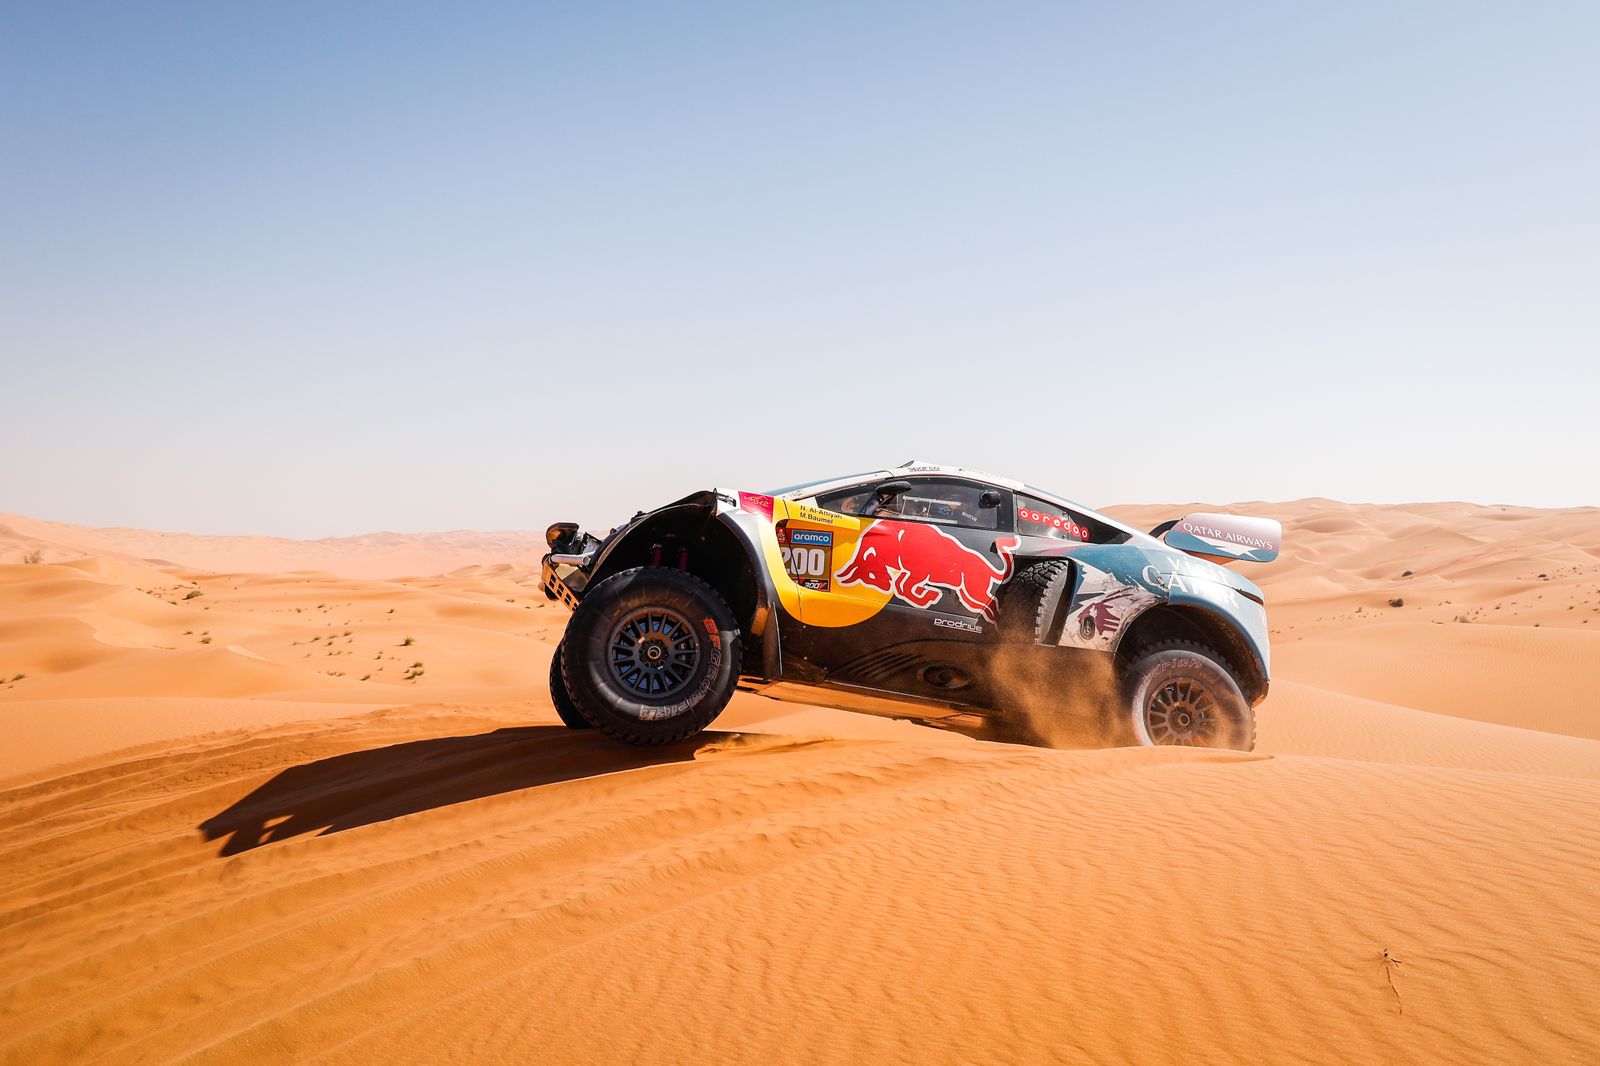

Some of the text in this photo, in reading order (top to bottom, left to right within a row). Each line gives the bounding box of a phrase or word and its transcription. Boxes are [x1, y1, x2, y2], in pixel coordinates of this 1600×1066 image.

[793, 533, 830, 542] aramco
[1019, 509, 1088, 540] ooredoo
[1183, 522, 1273, 550] QATAR AIRWAYS
[780, 546, 825, 576] 200
[1142, 565, 1240, 608] QATR
[934, 618, 983, 632] prodrive
